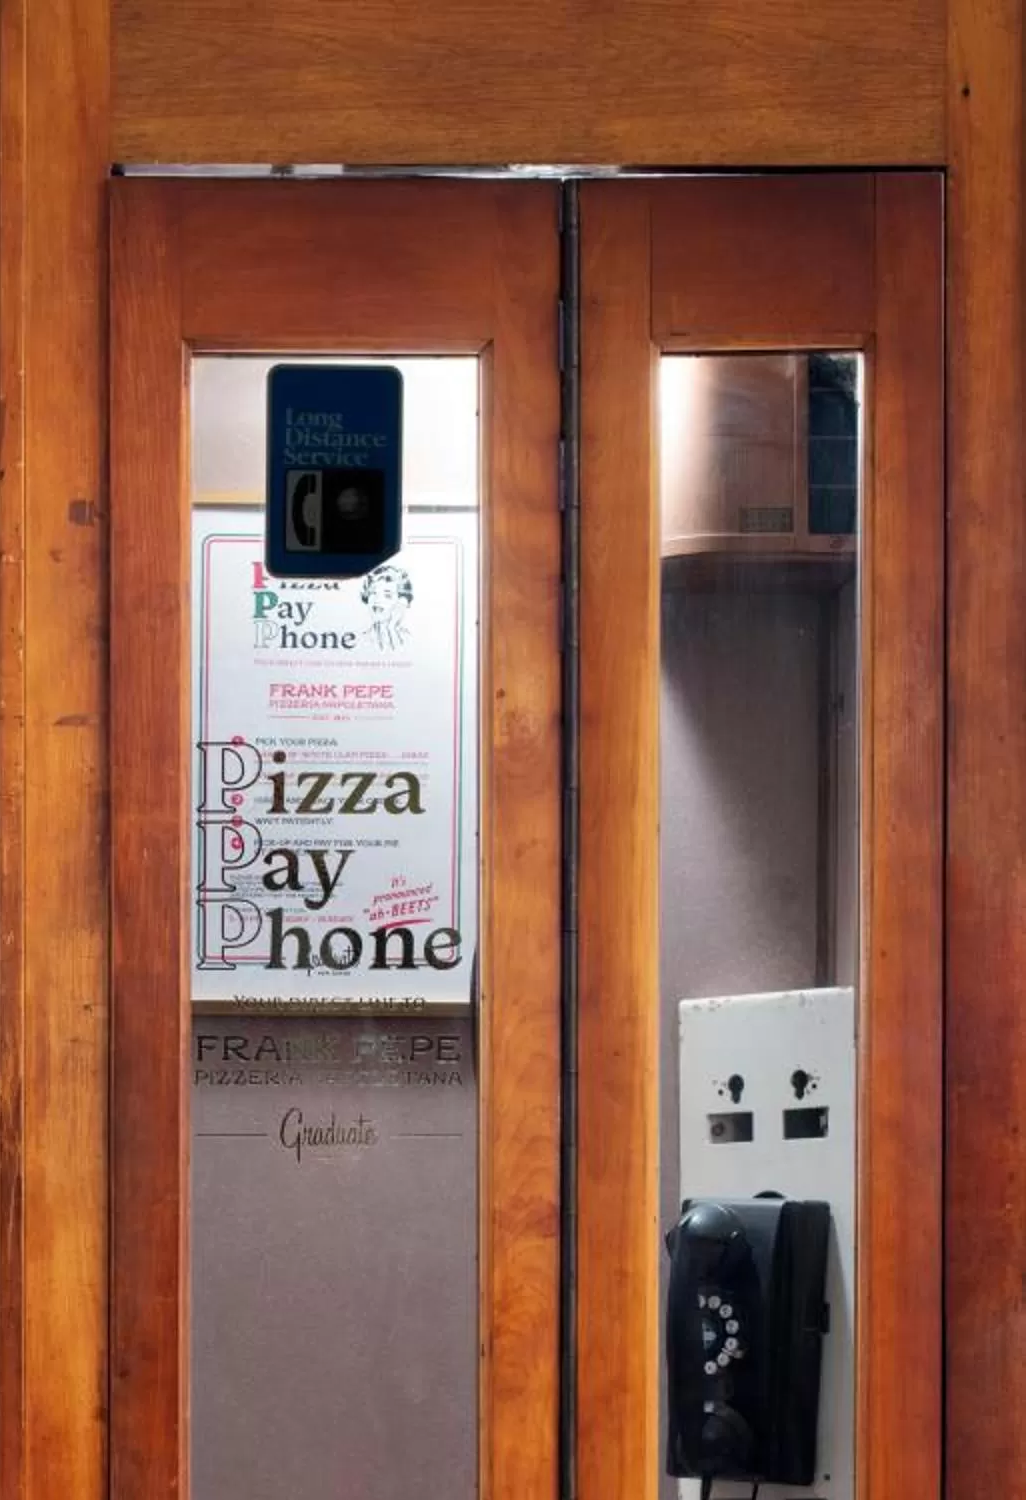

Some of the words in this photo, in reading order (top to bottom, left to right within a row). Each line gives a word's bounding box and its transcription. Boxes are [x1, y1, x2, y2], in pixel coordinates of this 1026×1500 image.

[285, 405, 344, 431] Long
[285, 427, 387, 448] Distance
[283, 447, 370, 466] Service
[253, 591, 314, 626] Pay
[253, 620, 357, 650] Phone
[269, 683, 337, 698] FRANK
[342, 684, 394, 699] PEPE
[196, 741, 426, 815] Pizza
[196, 820, 356, 911] Pay
[196, 897, 463, 971] Phone
[279, 1106, 380, 1162] Graduate
